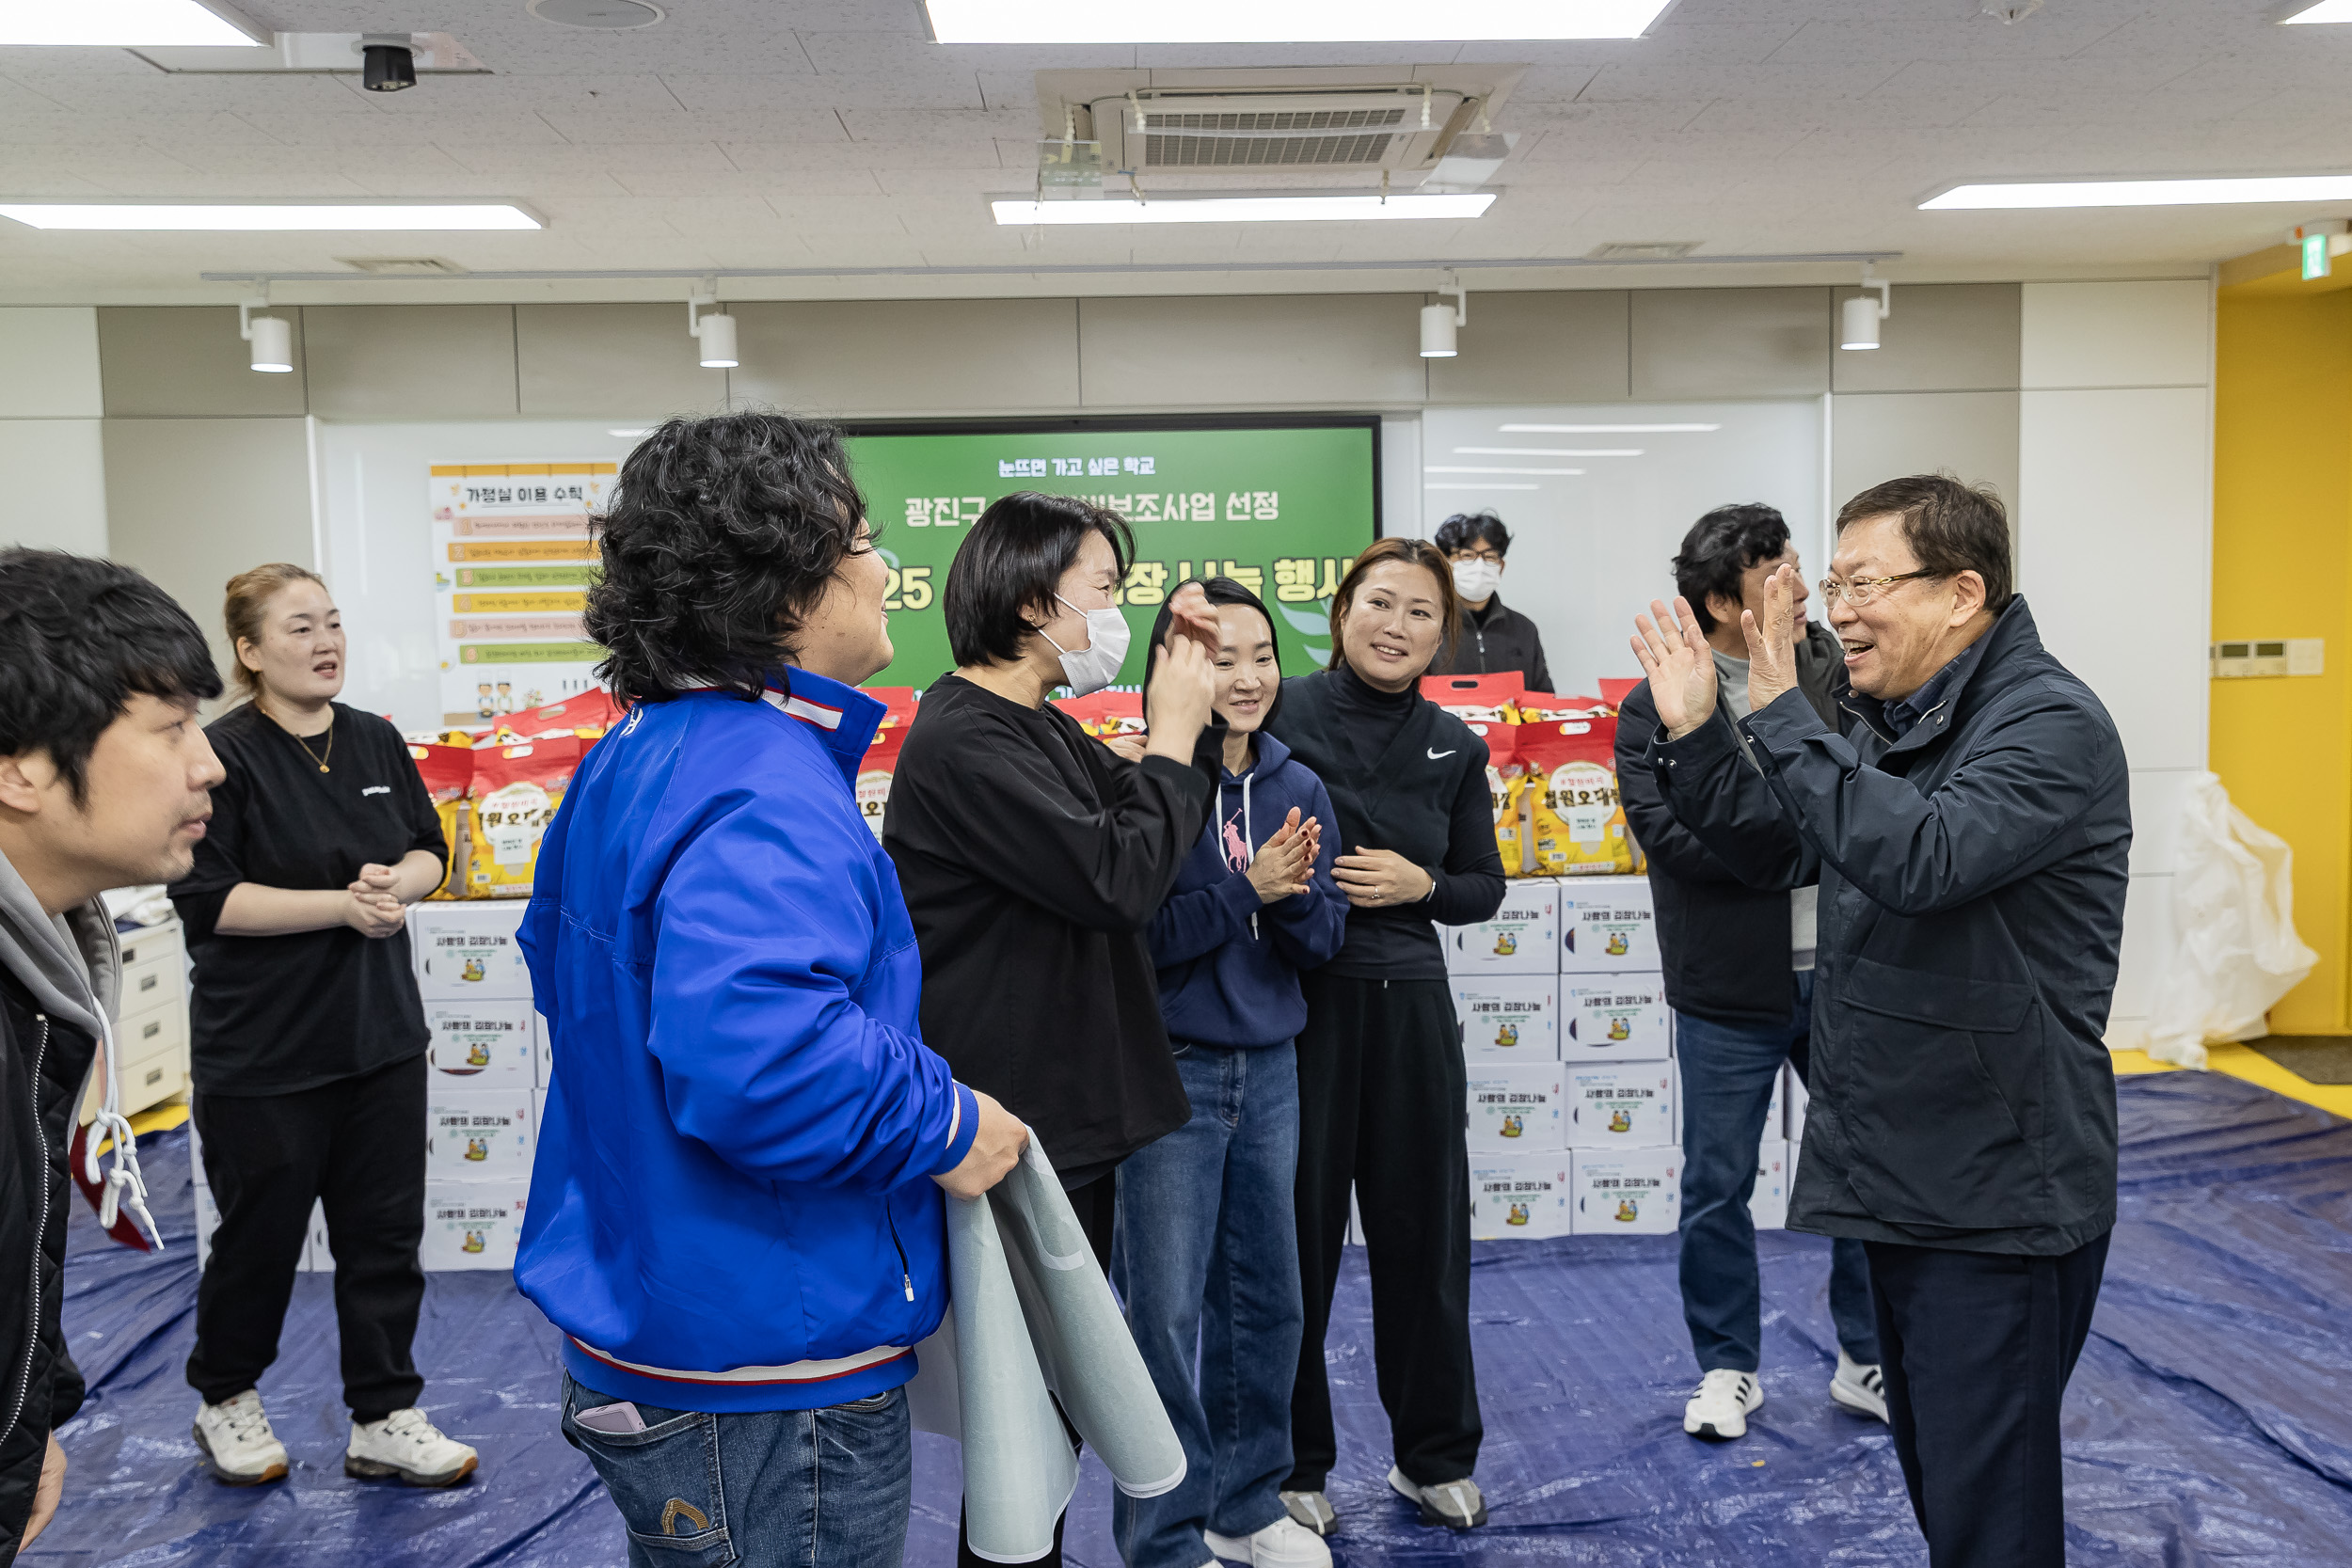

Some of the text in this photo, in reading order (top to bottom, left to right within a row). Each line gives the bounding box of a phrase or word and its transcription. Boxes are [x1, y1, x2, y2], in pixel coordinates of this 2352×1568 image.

[998, 455, 1156, 478] 눈뜨면 가고 싶은 학교
[518, 485, 548, 502] 이용
[904, 497, 987, 528] 광진구
[1225, 491, 1279, 522] 선정
[883, 566, 934, 611] 25
[1114, 561, 1169, 606] 장
